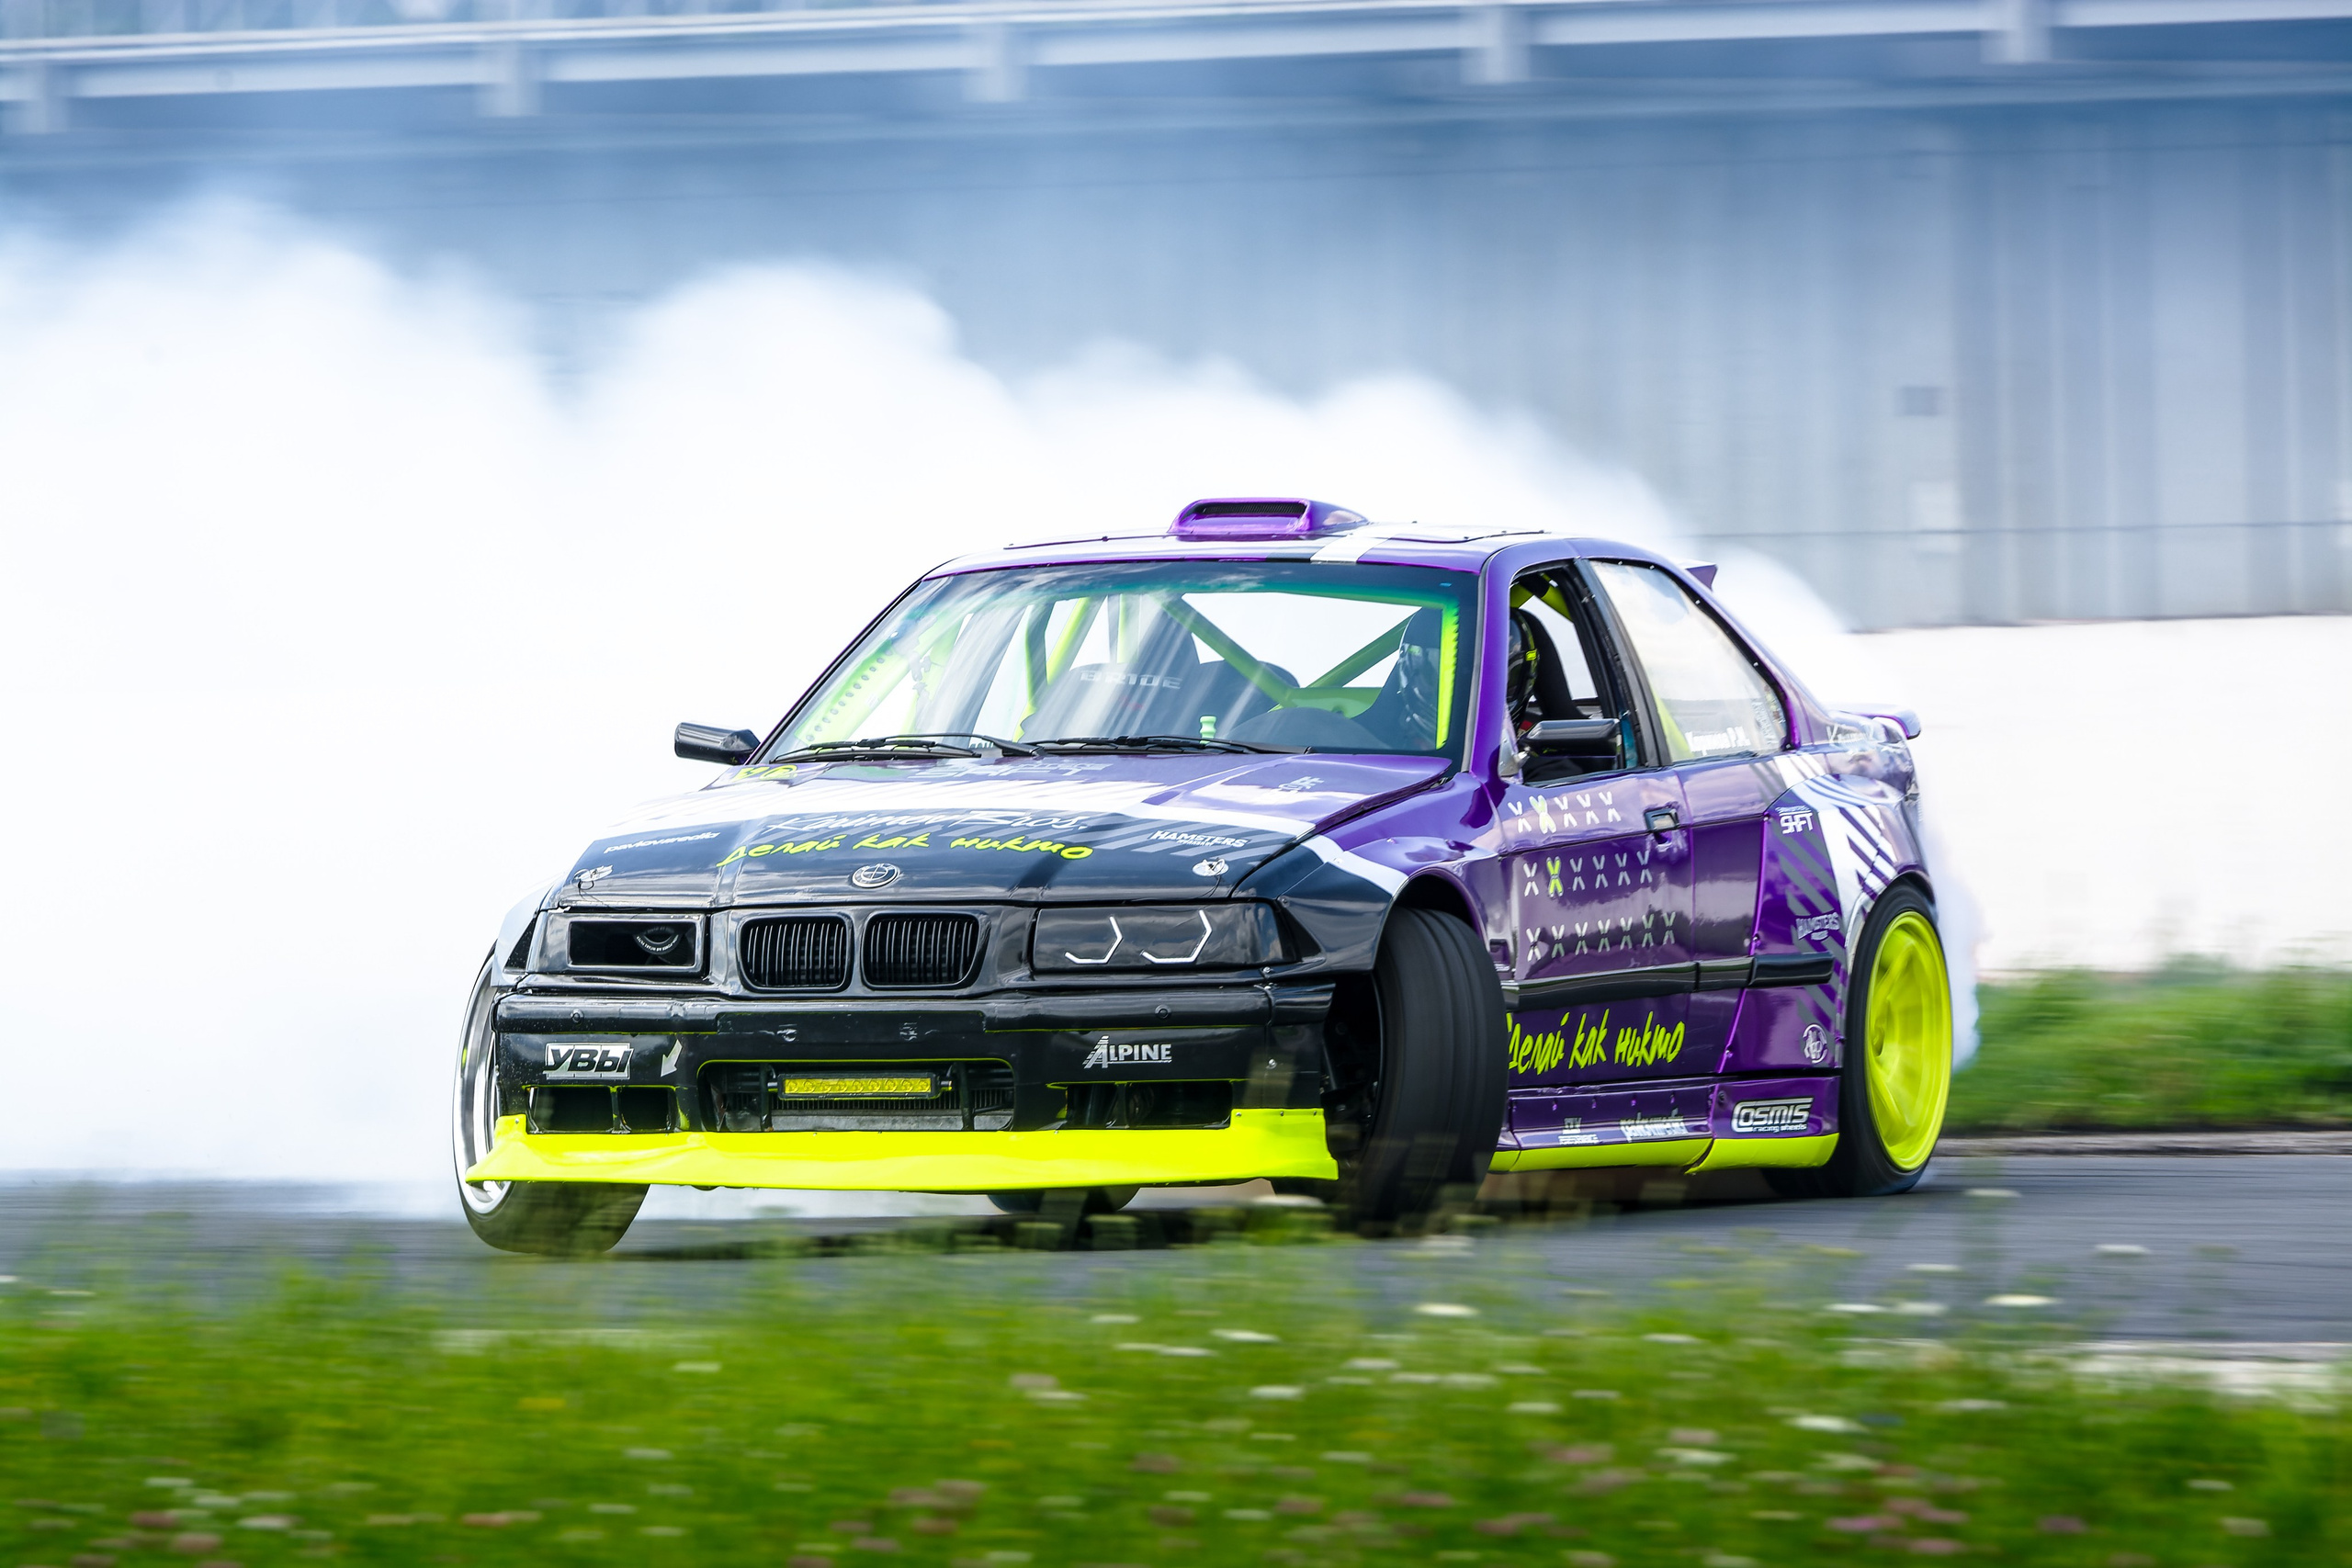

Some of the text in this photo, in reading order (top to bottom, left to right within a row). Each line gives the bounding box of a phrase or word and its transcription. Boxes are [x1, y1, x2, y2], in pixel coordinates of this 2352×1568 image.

[1080, 671, 1182, 690] BRIDE
[853, 833, 931, 850] как
[1149, 829, 1250, 848] HAMSTERS
[1568, 1009, 1610, 1069] как
[543, 1046, 633, 1074] УВЫ
[1082, 1035, 1172, 1069] ALPINE
[1753, 1122, 1807, 1134] racing wheels
